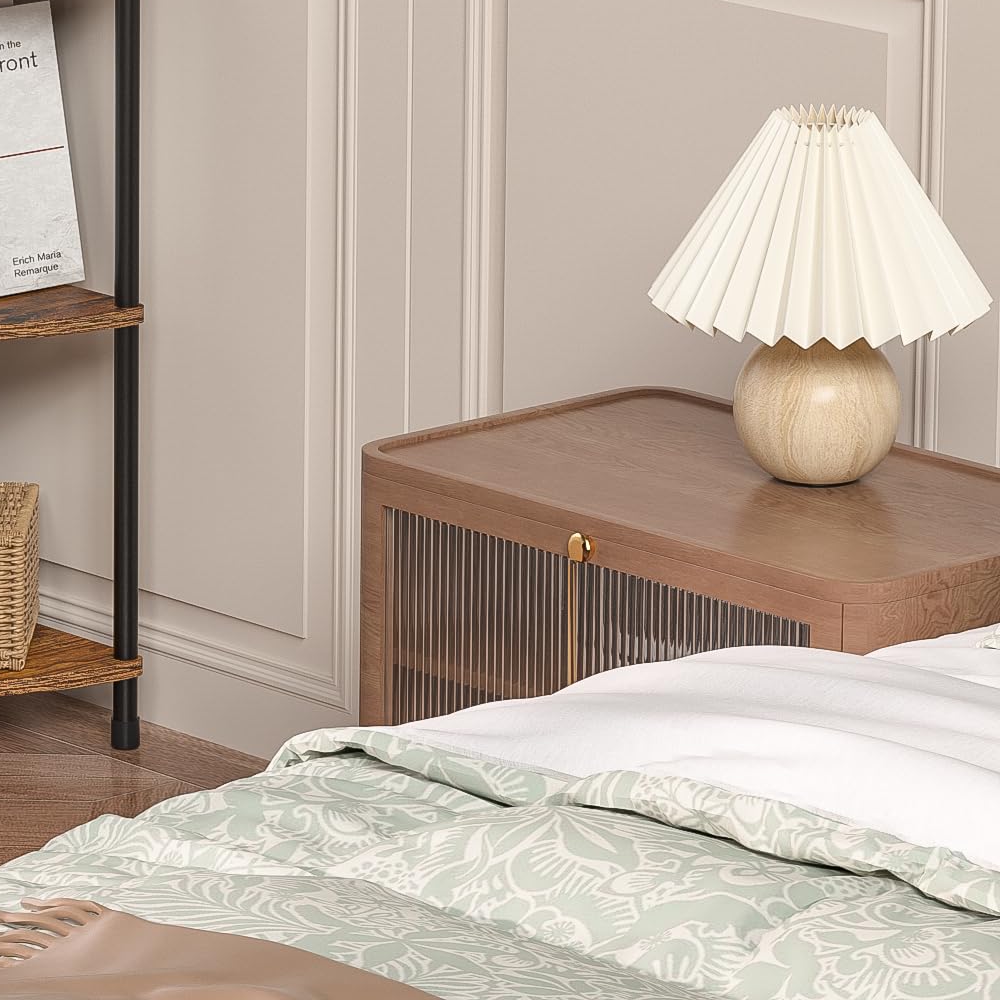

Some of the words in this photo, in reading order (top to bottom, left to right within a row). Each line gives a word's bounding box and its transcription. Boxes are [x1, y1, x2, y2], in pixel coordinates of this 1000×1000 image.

[6, 39, 22, 50] the
[12, 255, 35, 267] Erich
[37, 250, 62, 262] Maria
[14, 263, 60, 278] Remarque
